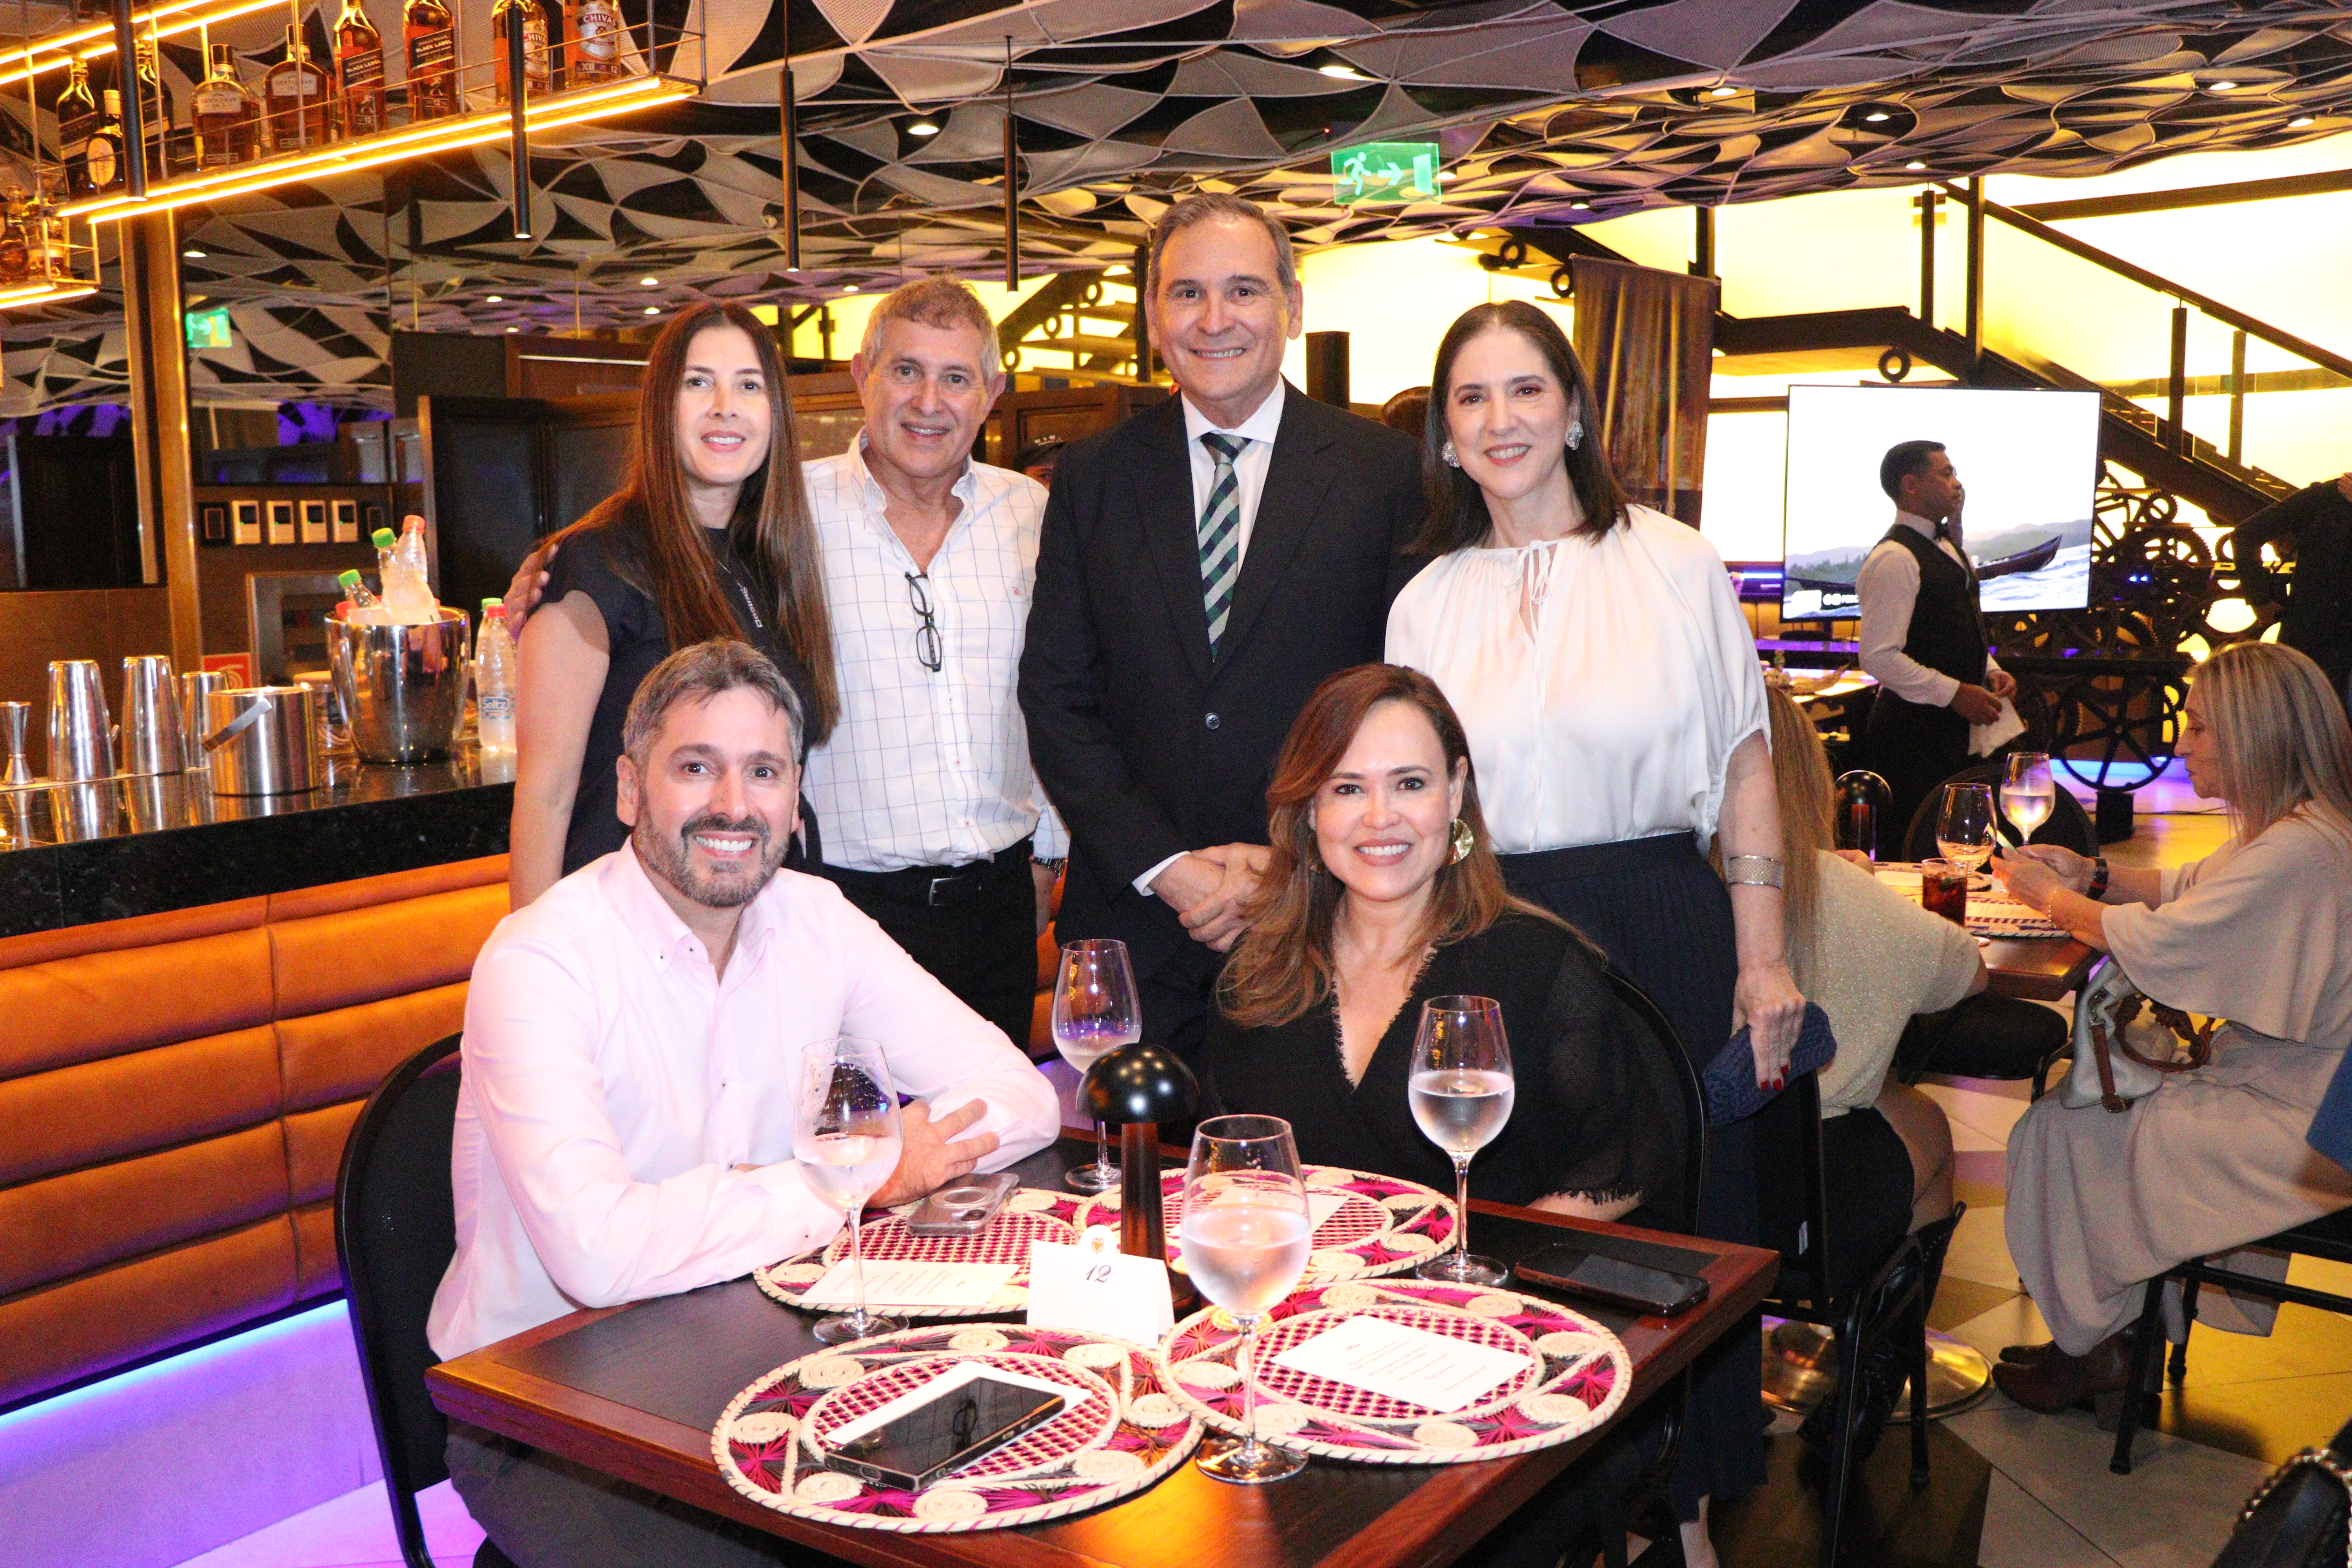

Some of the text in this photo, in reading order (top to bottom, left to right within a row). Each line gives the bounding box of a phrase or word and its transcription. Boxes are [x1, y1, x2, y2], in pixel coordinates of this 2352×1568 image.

[583, 14, 616, 27] CHIVAS
[416, 44, 434, 53] BLACK
[346, 64, 364, 73] BLACK
[1085, 1264, 1111, 1283] 12
